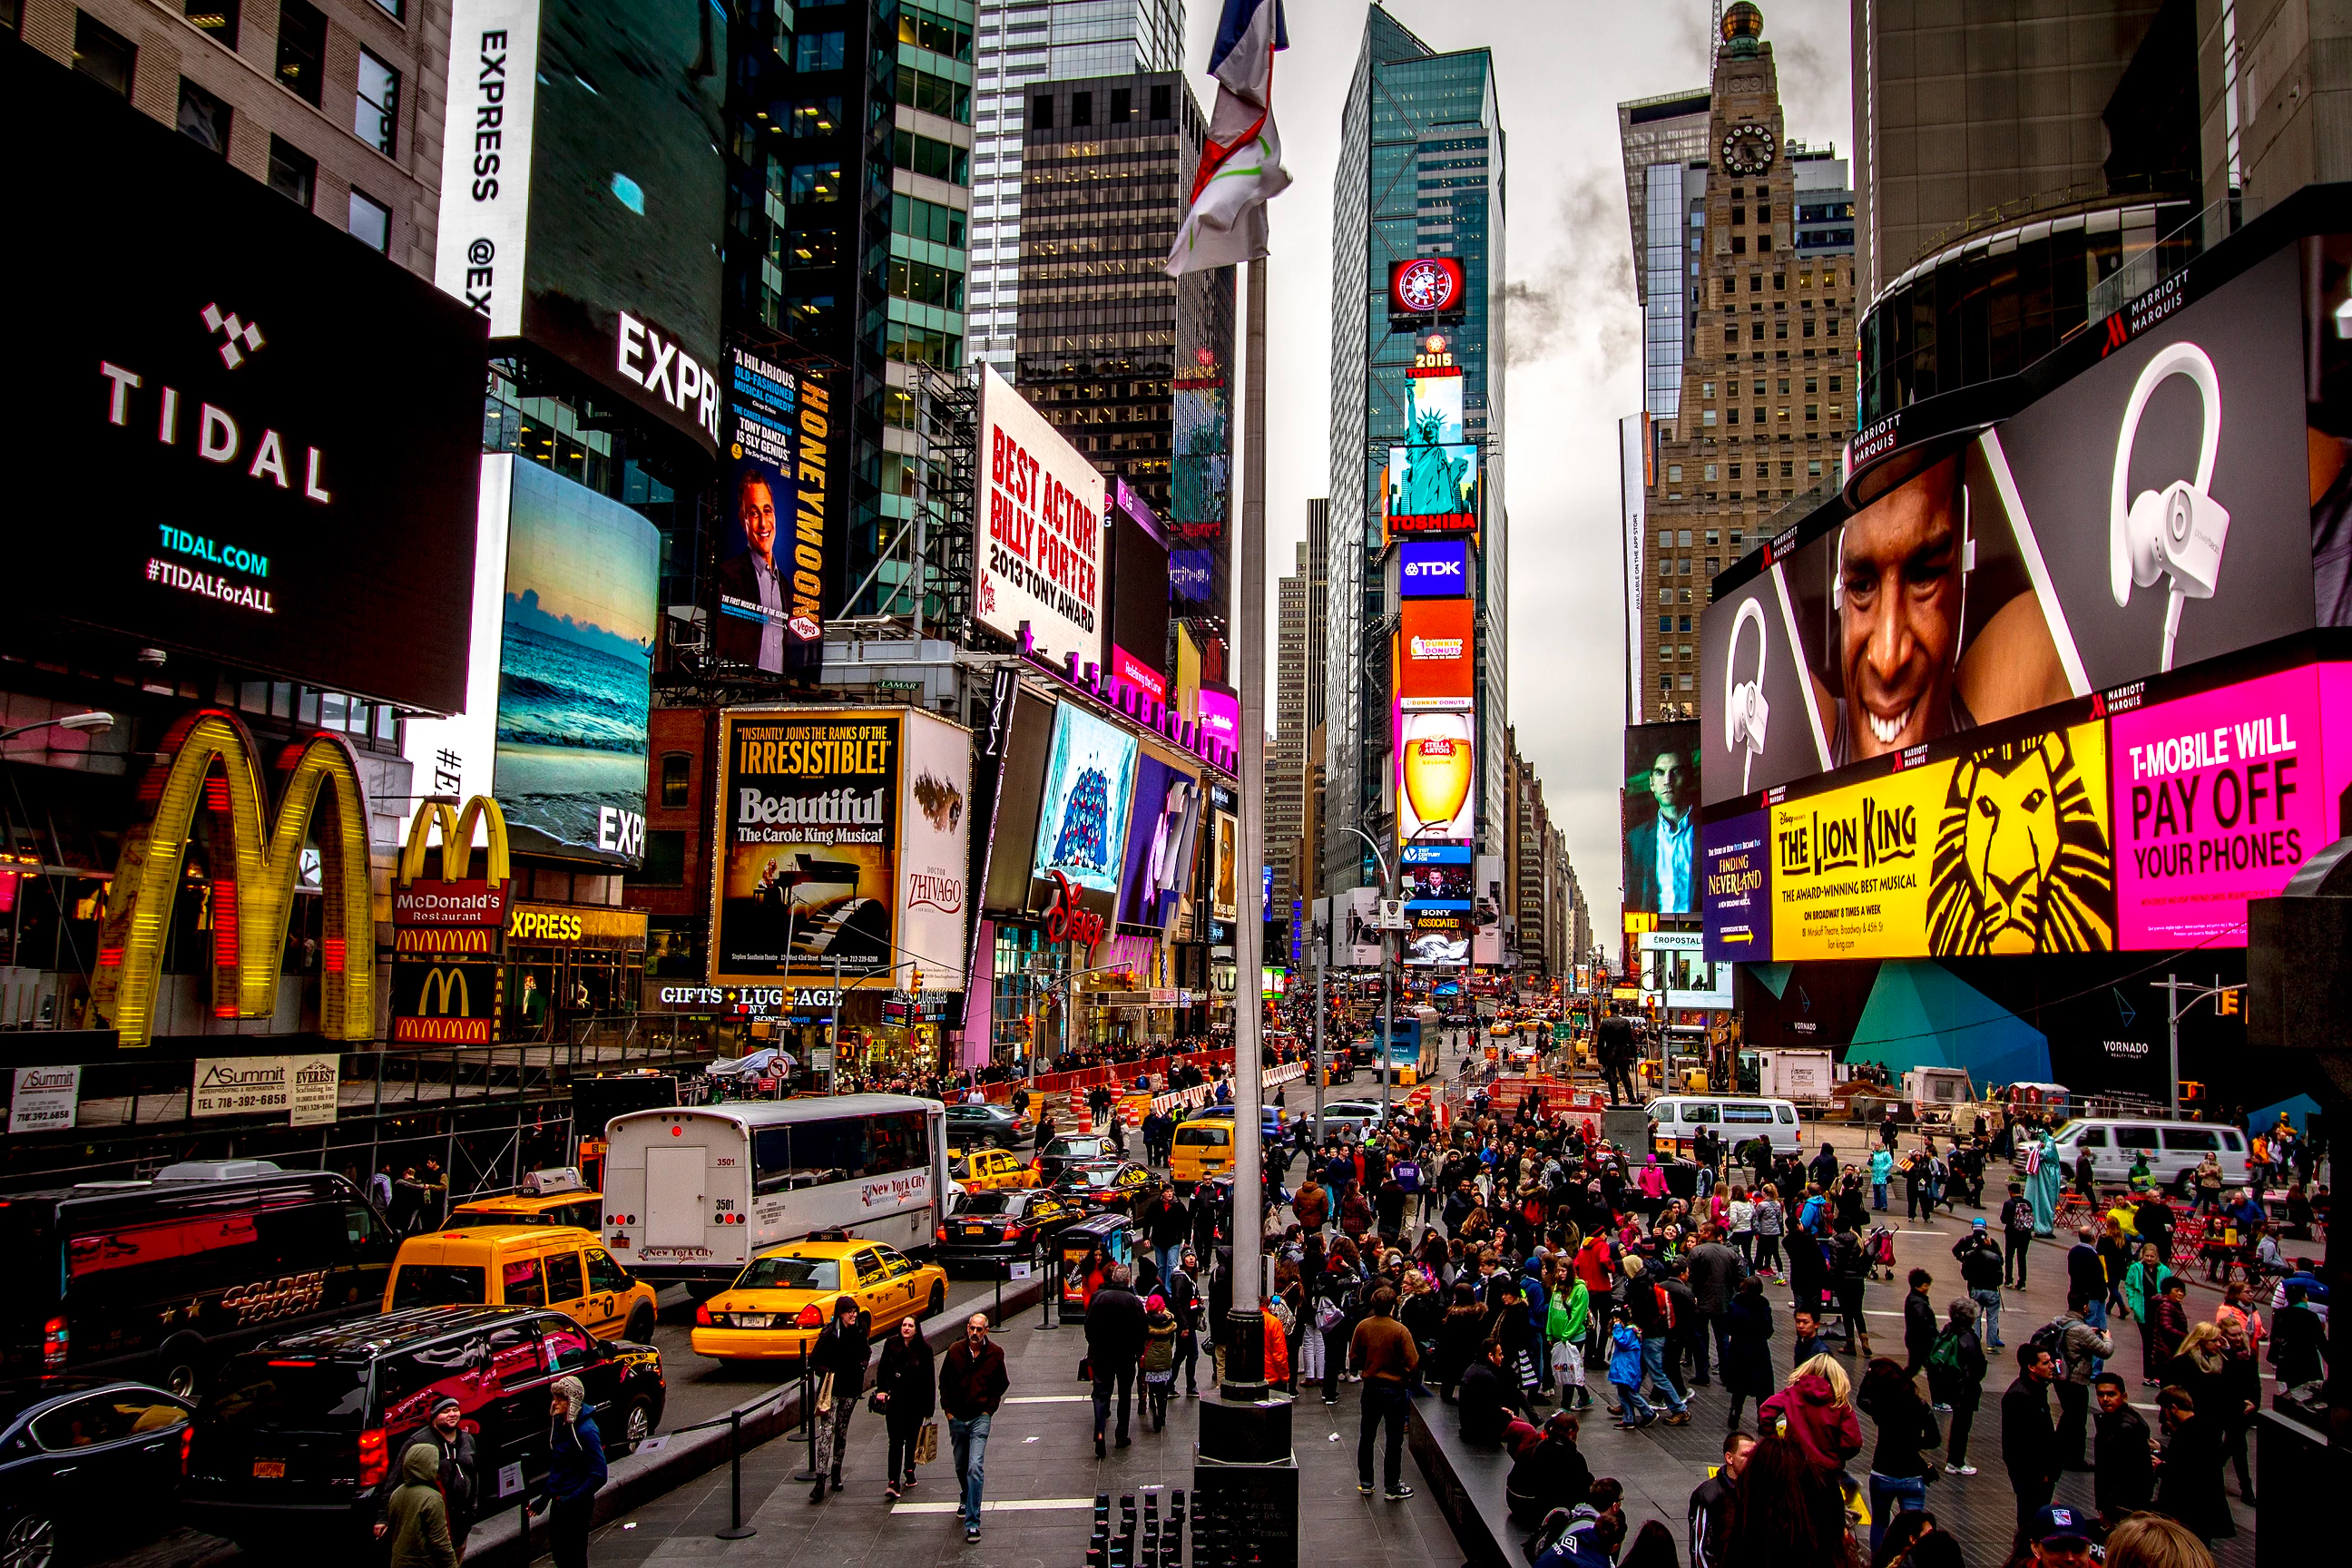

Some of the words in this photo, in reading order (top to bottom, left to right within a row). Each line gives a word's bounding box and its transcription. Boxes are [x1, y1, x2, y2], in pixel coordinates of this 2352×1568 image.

[471, 29, 508, 203] EXPRESS
[2132, 270, 2189, 316] MARRIOTT
[2132, 292, 2182, 334] MARQUIS
[1416, 353, 1453, 367] 2015
[744, 352, 797, 391] HILARIOUS,
[1406, 367, 1462, 378] TOSHIBA
[734, 379, 764, 401] MUSICAL
[735, 366, 794, 402] OLD-FASHIONED
[100, 360, 331, 505] TIDAL
[736, 429, 745, 444] IS
[745, 434, 760, 449] SLY
[740, 416, 760, 435] TONY
[761, 426, 786, 446] DANZA
[1854, 414, 1901, 448] MARRIOTT
[1854, 435, 1895, 466] MARQUIS
[792, 381, 829, 623] HONEYMOON
[992, 423, 1040, 508] BEST
[1043, 471, 1097, 564] ACTOR!
[1389, 513, 1476, 531] TOSHIBA
[1773, 526, 1798, 548] MARRIOTT
[159, 524, 270, 578] TIDAL.COM
[990, 487, 1034, 566] BILLY
[1037, 525, 1096, 609] PORTER
[1773, 540, 1795, 560] MARQUIS
[1417, 561, 1461, 576] TDK
[145, 559, 275, 614] #TIDALforALL
[990, 543, 1024, 589] 2013
[1025, 569, 1058, 615] TONY
[1058, 586, 1095, 634] AWARD
[730, 596, 740, 606] FIRST
[740, 600, 756, 611] MUSICAL
[797, 619, 816, 635] Vegas
[1125, 661, 1145, 688] Redefining
[881, 681, 916, 690] LAMAR
[2108, 681, 2144, 701] MARRIOTT
[2109, 695, 2141, 713] MARQUIS
[785, 727, 810, 740] JOINS
[811, 727, 828, 740] THE
[828, 727, 858, 740] RANKS
[859, 727, 871, 740] OF
[871, 727, 887, 740] THE
[1137, 691, 1234, 773] BROADWA
[2234, 713, 2297, 760] WILL
[1905, 745, 1928, 759] MARRIOTT
[1905, 755, 1926, 768] MARQUIS
[738, 787, 885, 825] Beautiful
[2132, 774, 2201, 841] PAY
[2212, 757, 2298, 830] OFF
[738, 827, 761, 842] The
[762, 827, 803, 843] Carole
[804, 827, 834, 846] King
[835, 828, 883, 843] Musical
[1779, 827, 1808, 867] THE
[1812, 810, 1858, 877] LION
[1863, 796, 1916, 868] KING
[1719, 854, 1749, 873] FINDING
[2133, 841, 2194, 880] YOUR
[2199, 828, 2303, 875] PHONES
[926, 866, 946, 876] DOCTOR
[907, 873, 962, 909] ZHIVAGO
[1708, 869, 1762, 896] NEVERLAND
[1782, 890, 1795, 903] THE
[1796, 880, 1859, 901] AWARD-WINNING
[1860, 877, 1878, 893] BEST
[1879, 873, 1917, 891] MUSICAL
[397, 894, 500, 909] McDonald's
[413, 911, 481, 921] Restaurant
[1417, 917, 1460, 928] ASSOCIATED
[1804, 911, 1812, 921] ON
[1812, 908, 1839, 920] BROADWAY
[1840, 907, 1845, 917] 8
[1846, 906, 1859, 916] TIMES
[1860, 906, 1865, 916] A
[1866, 904, 1881, 916] WEEK
[507, 911, 583, 940] XPRESS
[1807, 926, 1823, 936] Minskoff
[1840, 924, 1861, 936] Broadway
[1867, 922, 1877, 932] 45th
[661, 986, 723, 1004] GIFTS
[740, 988, 843, 1006] LUGAGE
[918, 991, 948, 1004] LUGGAGE
[748, 1004, 767, 1014] NY
[1794, 1022, 1817, 1030] VORNADO
[2102, 1040, 2149, 1054] VORNADO
[32, 1070, 74, 1086] Summit
[218, 1066, 286, 1083] Summit
[296, 1069, 336, 1084] EVEREST
[296, 1085, 323, 1094] Scaffolding
[198, 1098, 213, 1110] TEL
[218, 1093, 287, 1109] 718-392-6858
[16, 1110, 70, 1122] 718.392.6858
[717, 1158, 735, 1166] 3501
[871, 1183, 889, 1197] New
[891, 1178, 910, 1192] York
[911, 1175, 926, 1190] City
[716, 1199, 734, 1210] 3501
[649, 1249, 669, 1257] New
[671, 1249, 693, 1258] York
[695, 1249, 714, 1258] City
[220, 1269, 331, 1309] GOLDEN
[237, 1290, 324, 1326] TOUCH
